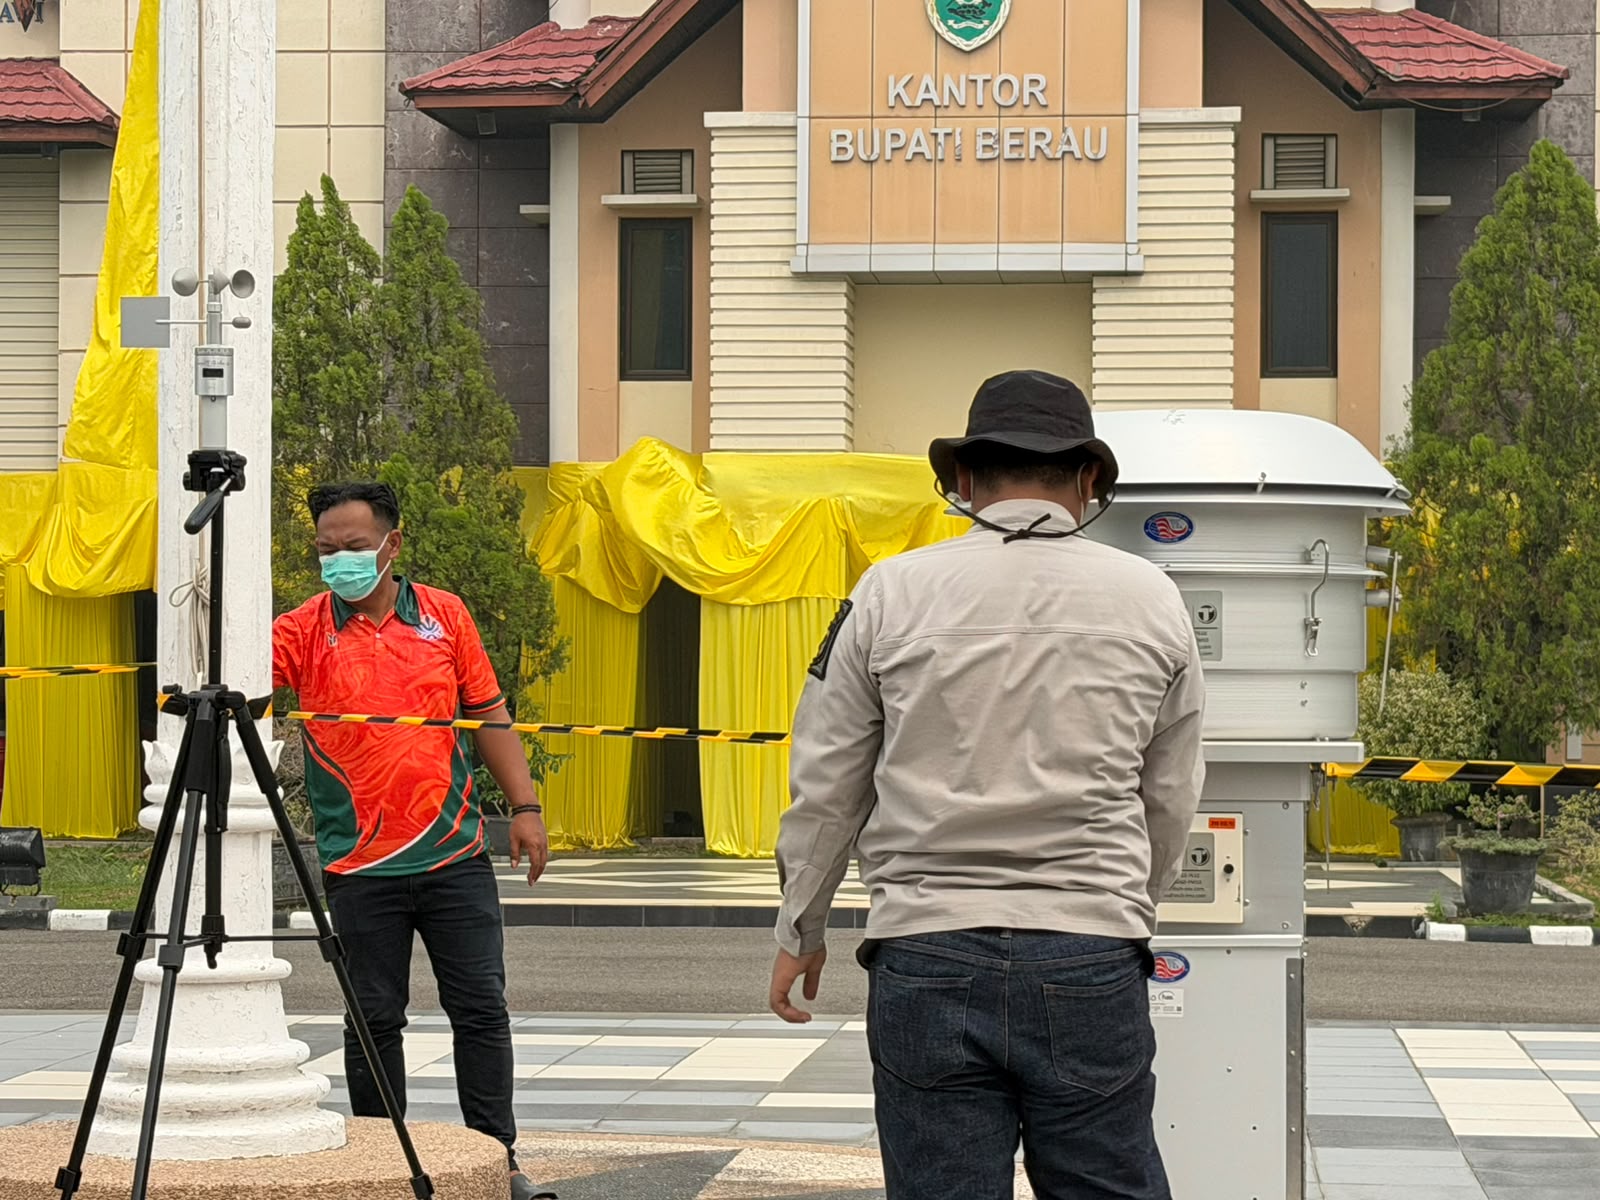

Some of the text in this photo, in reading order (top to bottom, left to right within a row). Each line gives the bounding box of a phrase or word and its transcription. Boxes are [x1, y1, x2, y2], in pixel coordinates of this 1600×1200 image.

[887, 73, 1049, 108] KANTOR
[830, 126, 1108, 162] BUPATI BERAU
